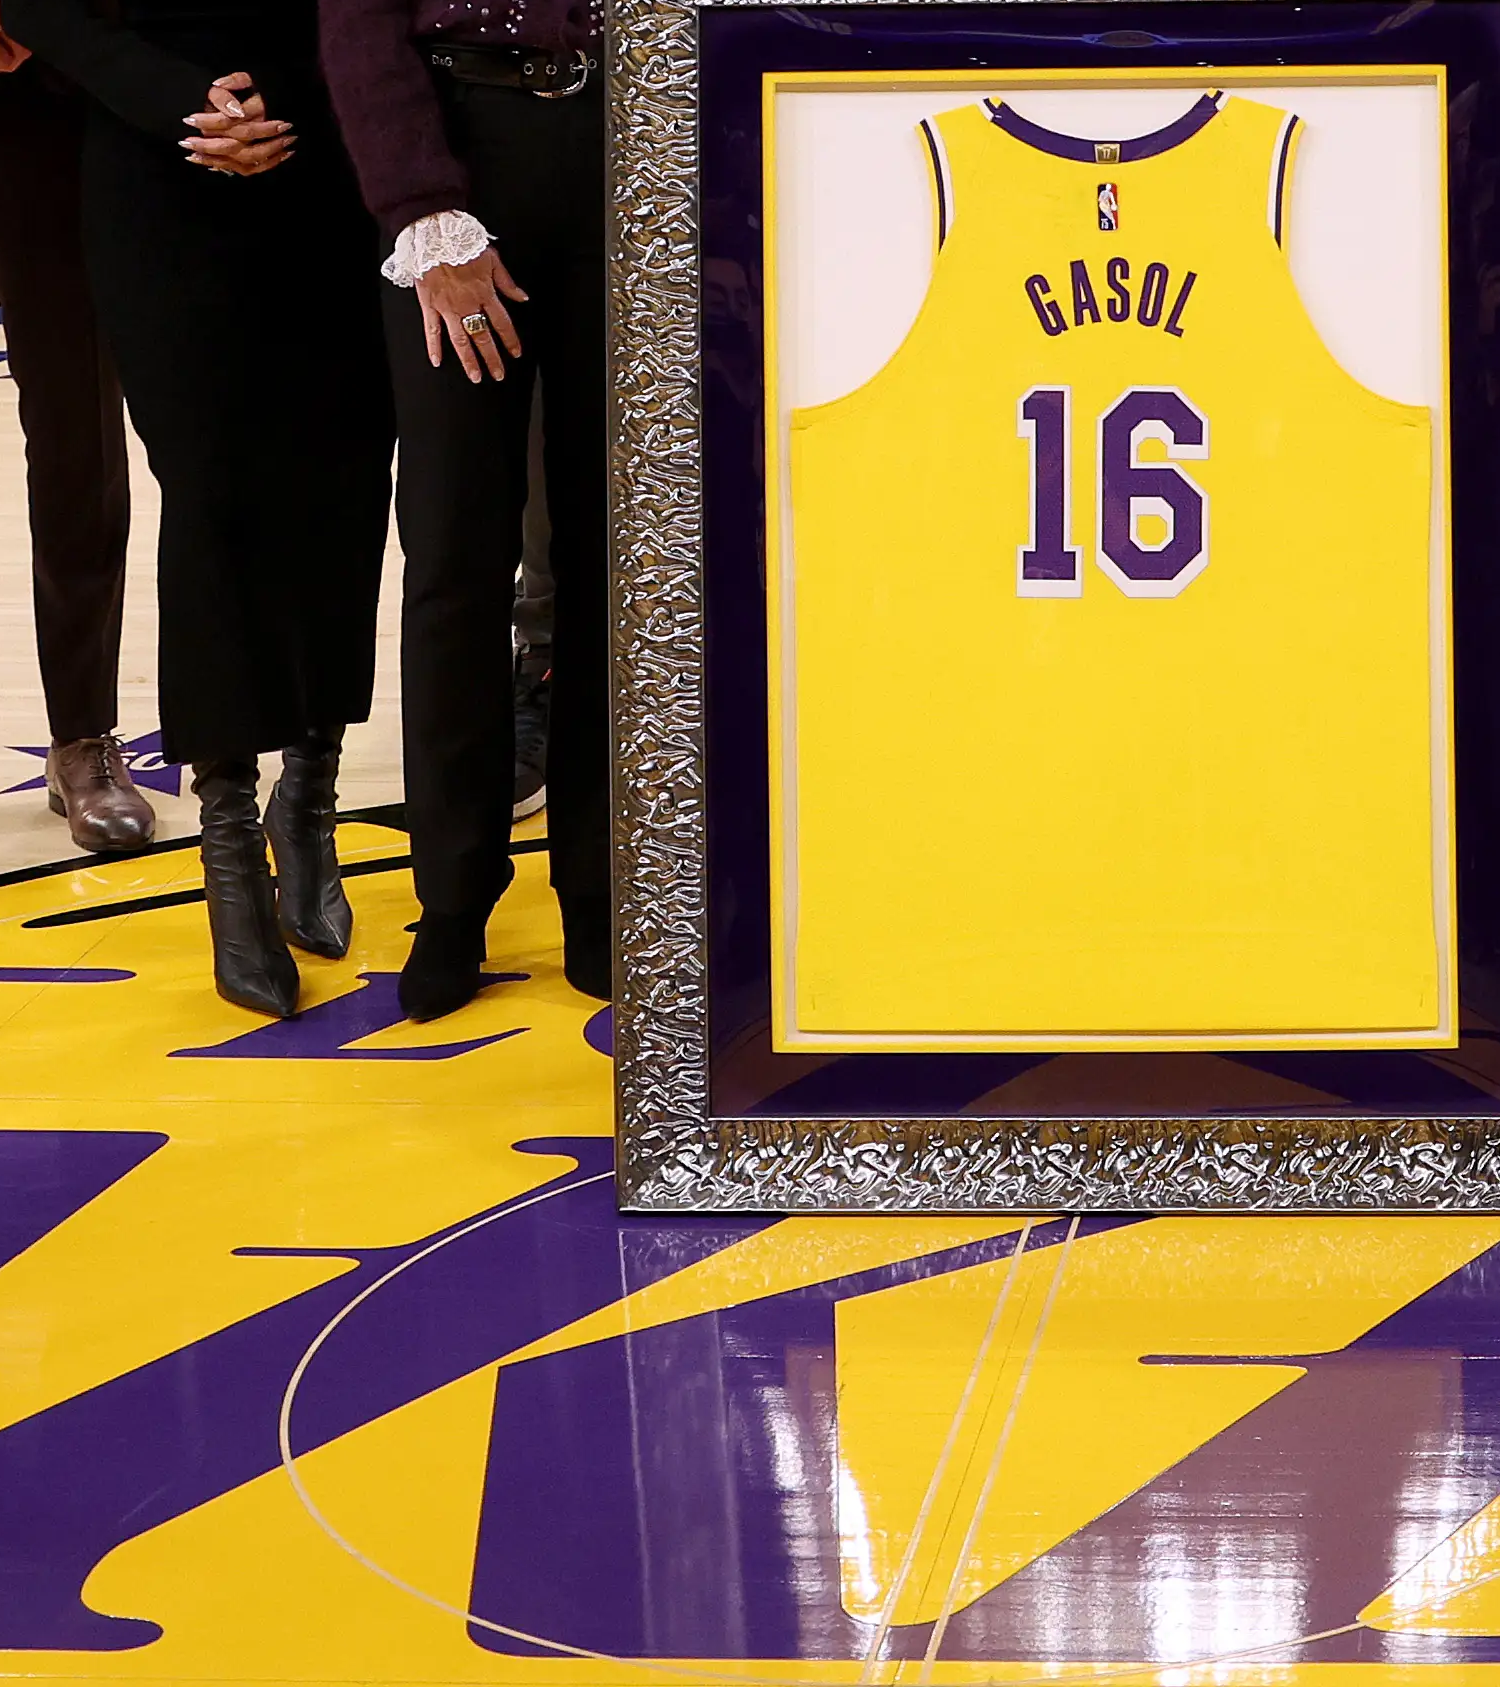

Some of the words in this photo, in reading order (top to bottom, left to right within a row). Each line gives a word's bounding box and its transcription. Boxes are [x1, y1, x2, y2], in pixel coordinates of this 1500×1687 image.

[431, 54, 453, 67] D&G
[1022, 257, 1200, 342] GASOL
[1013, 382, 1212, 601] 16
